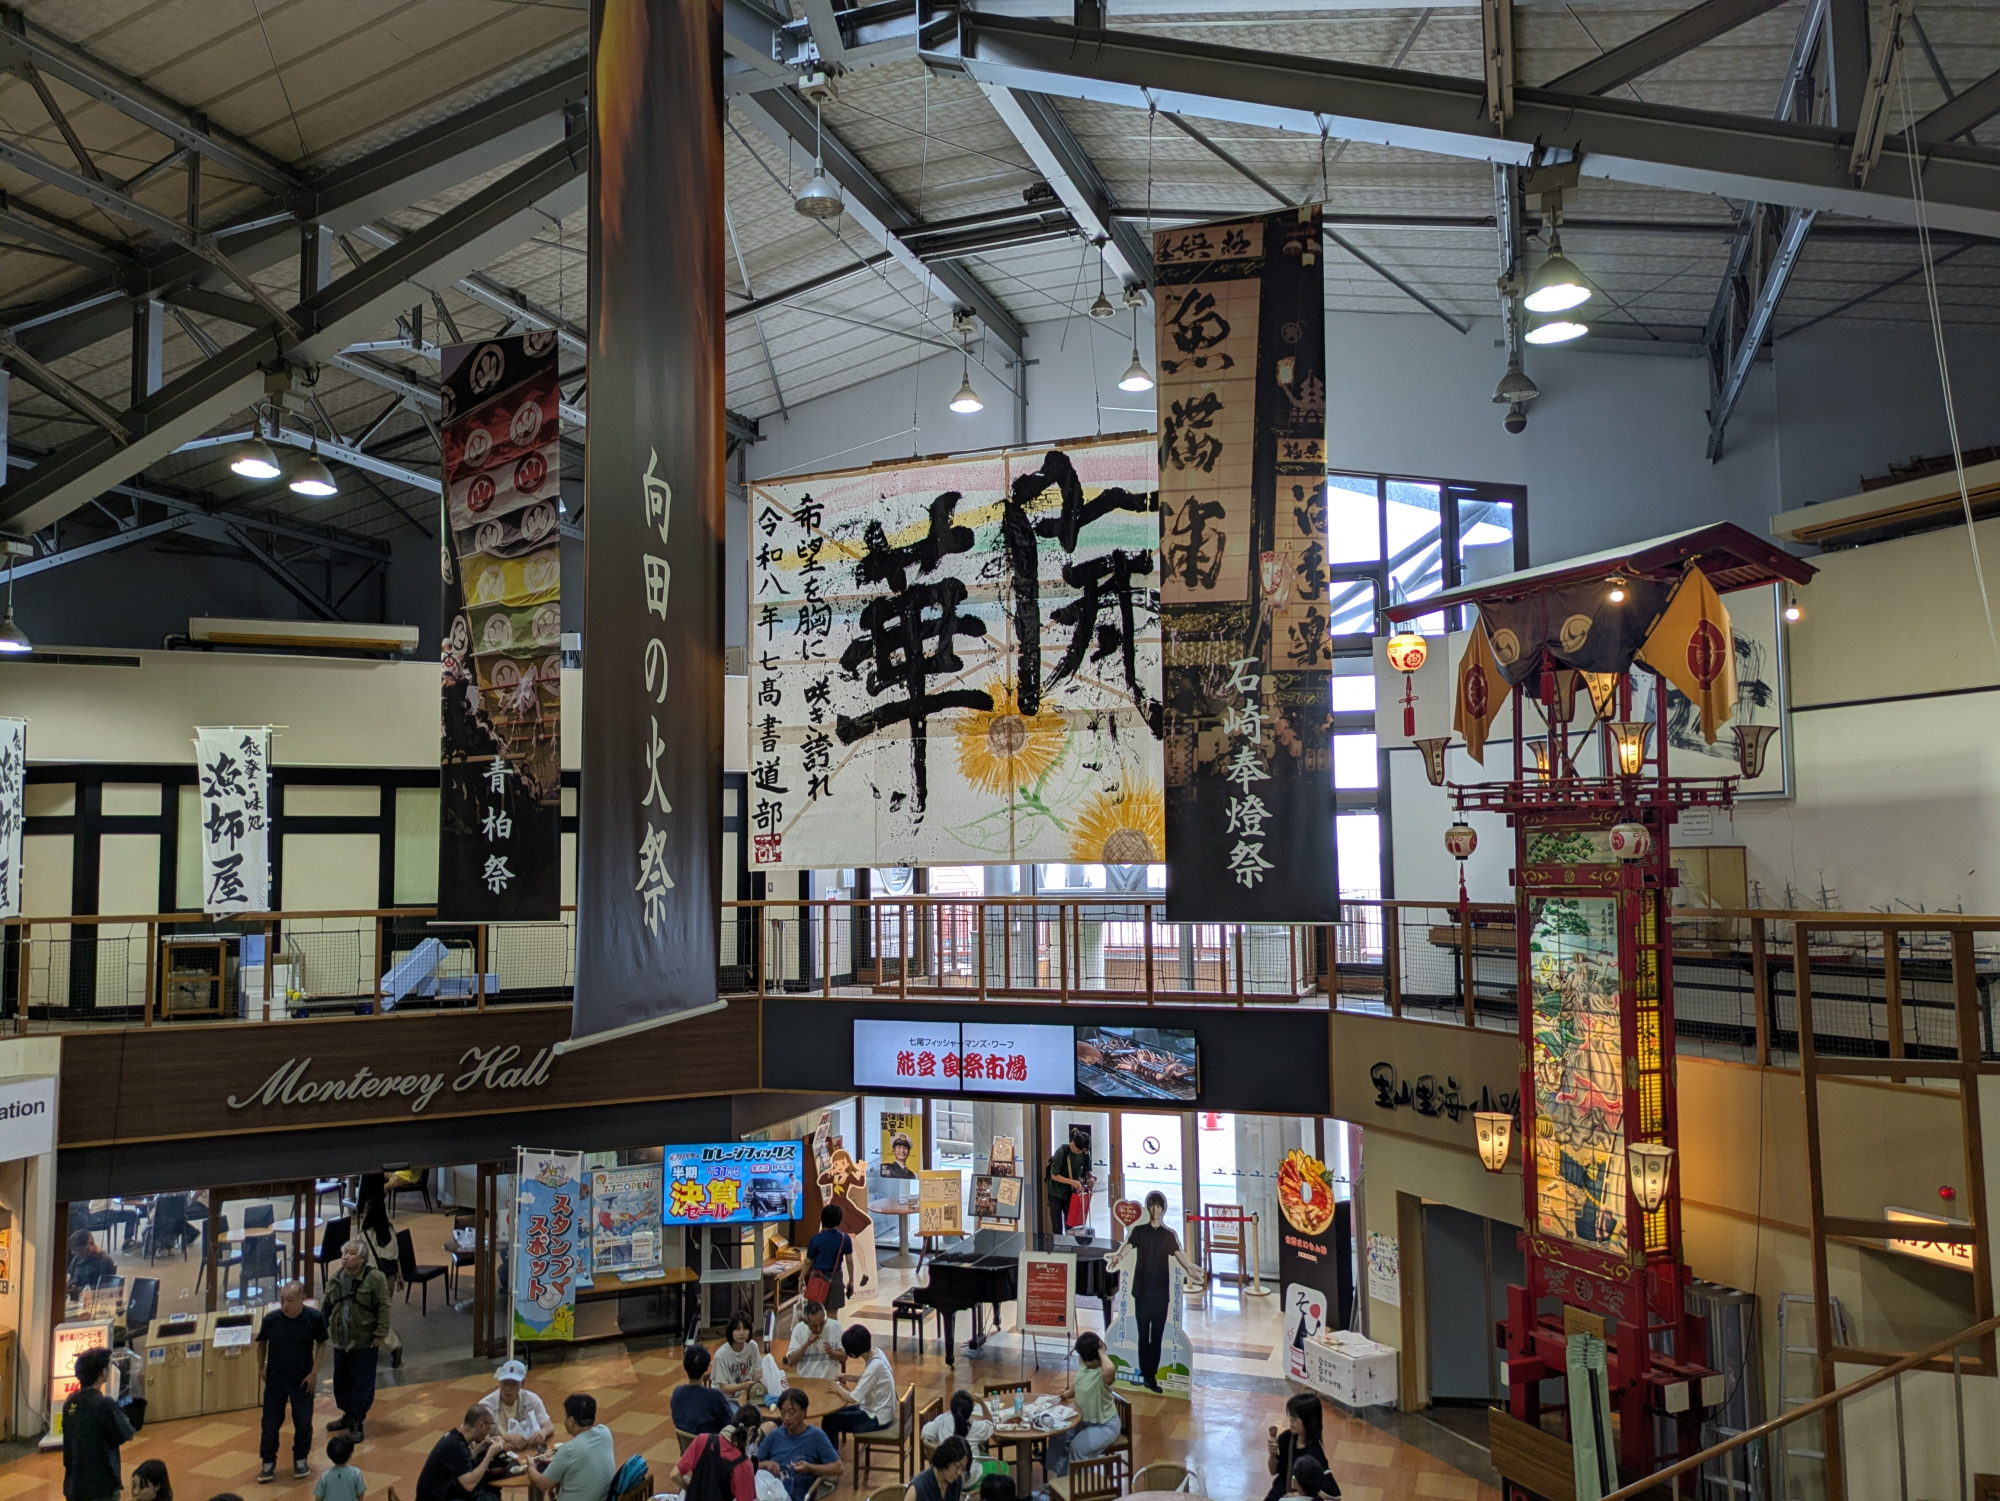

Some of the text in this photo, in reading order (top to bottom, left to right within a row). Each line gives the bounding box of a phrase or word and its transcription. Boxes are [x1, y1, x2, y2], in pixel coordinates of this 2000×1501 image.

[791, 492, 835, 801] 希望を胸に 咲き誇れ
[635, 446, 675, 938] 向田の火祭
[239, 734, 265, 832] 能登の味処
[1224, 656, 1276, 889] 石崎奉燈祭
[201, 751, 249, 905] 漁師屋
[481, 755, 516, 895] 青柏祭
[909, 1037, 1015, 1049] 七尾フィッシャーマンズ・ワーフ
[227, 1045, 556, 1112] Monterey Hall
[702, 1145, 797, 1162] ガレージフィックス
[888, 1112, 897, 1137] 保安官
[896, 1113, 905, 1129] 海上
[670, 1178, 741, 1217] 決算
[672, 1166, 698, 1179] 半期
[551, 1194, 574, 1278] スタンプ
[685, 1203, 729, 1220] セール
[527, 1215, 550, 1300] スポット
[64, 1382, 81, 1394] uc
